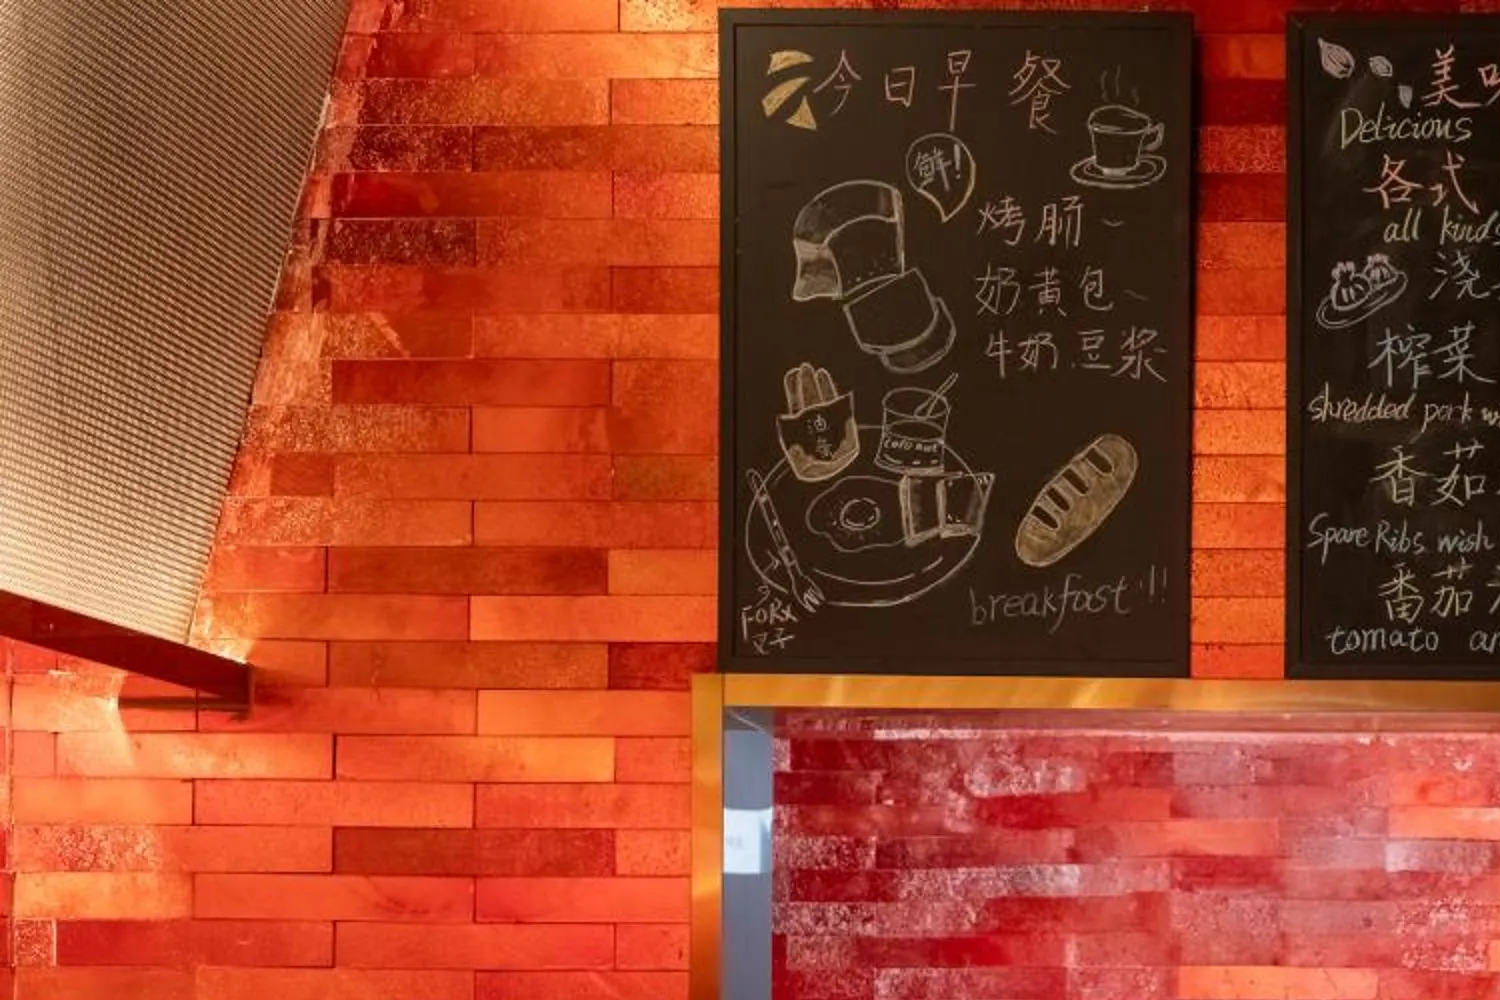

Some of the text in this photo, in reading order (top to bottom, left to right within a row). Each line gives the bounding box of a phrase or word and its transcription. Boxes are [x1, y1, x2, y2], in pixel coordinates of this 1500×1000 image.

[1341, 102, 1473, 150] Delicious
[1383, 208, 1422, 243] all
[1307, 511, 1371, 566] Spare
[1374, 518, 1426, 556] Ribs
[969, 573, 1131, 635] breakfast
[1326, 624, 1440, 656] tomato
